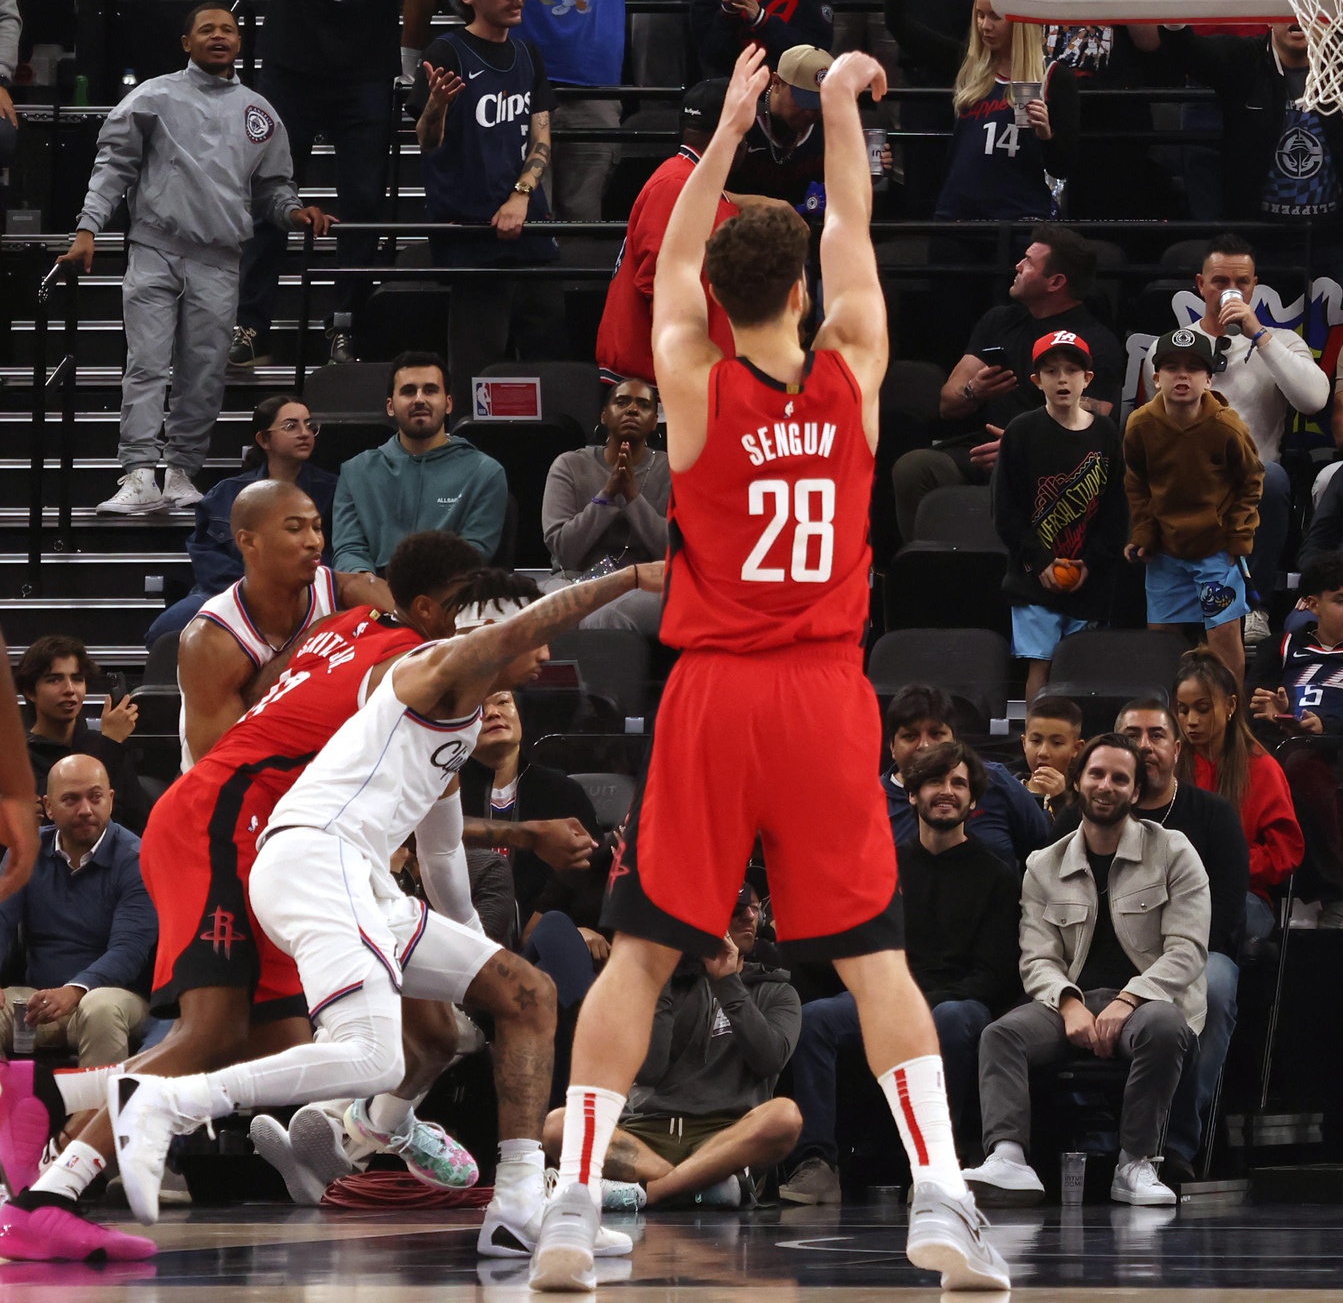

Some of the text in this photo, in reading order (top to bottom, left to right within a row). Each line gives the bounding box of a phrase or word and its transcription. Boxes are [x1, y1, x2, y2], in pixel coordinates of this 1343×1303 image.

[475, 90, 532, 129] Clips
[981, 121, 1021, 158] 14
[1050, 329, 1077, 346] LA
[740, 420, 837, 466] SENGUN
[743, 479, 837, 587] 28
[1303, 685, 1326, 707] 5
